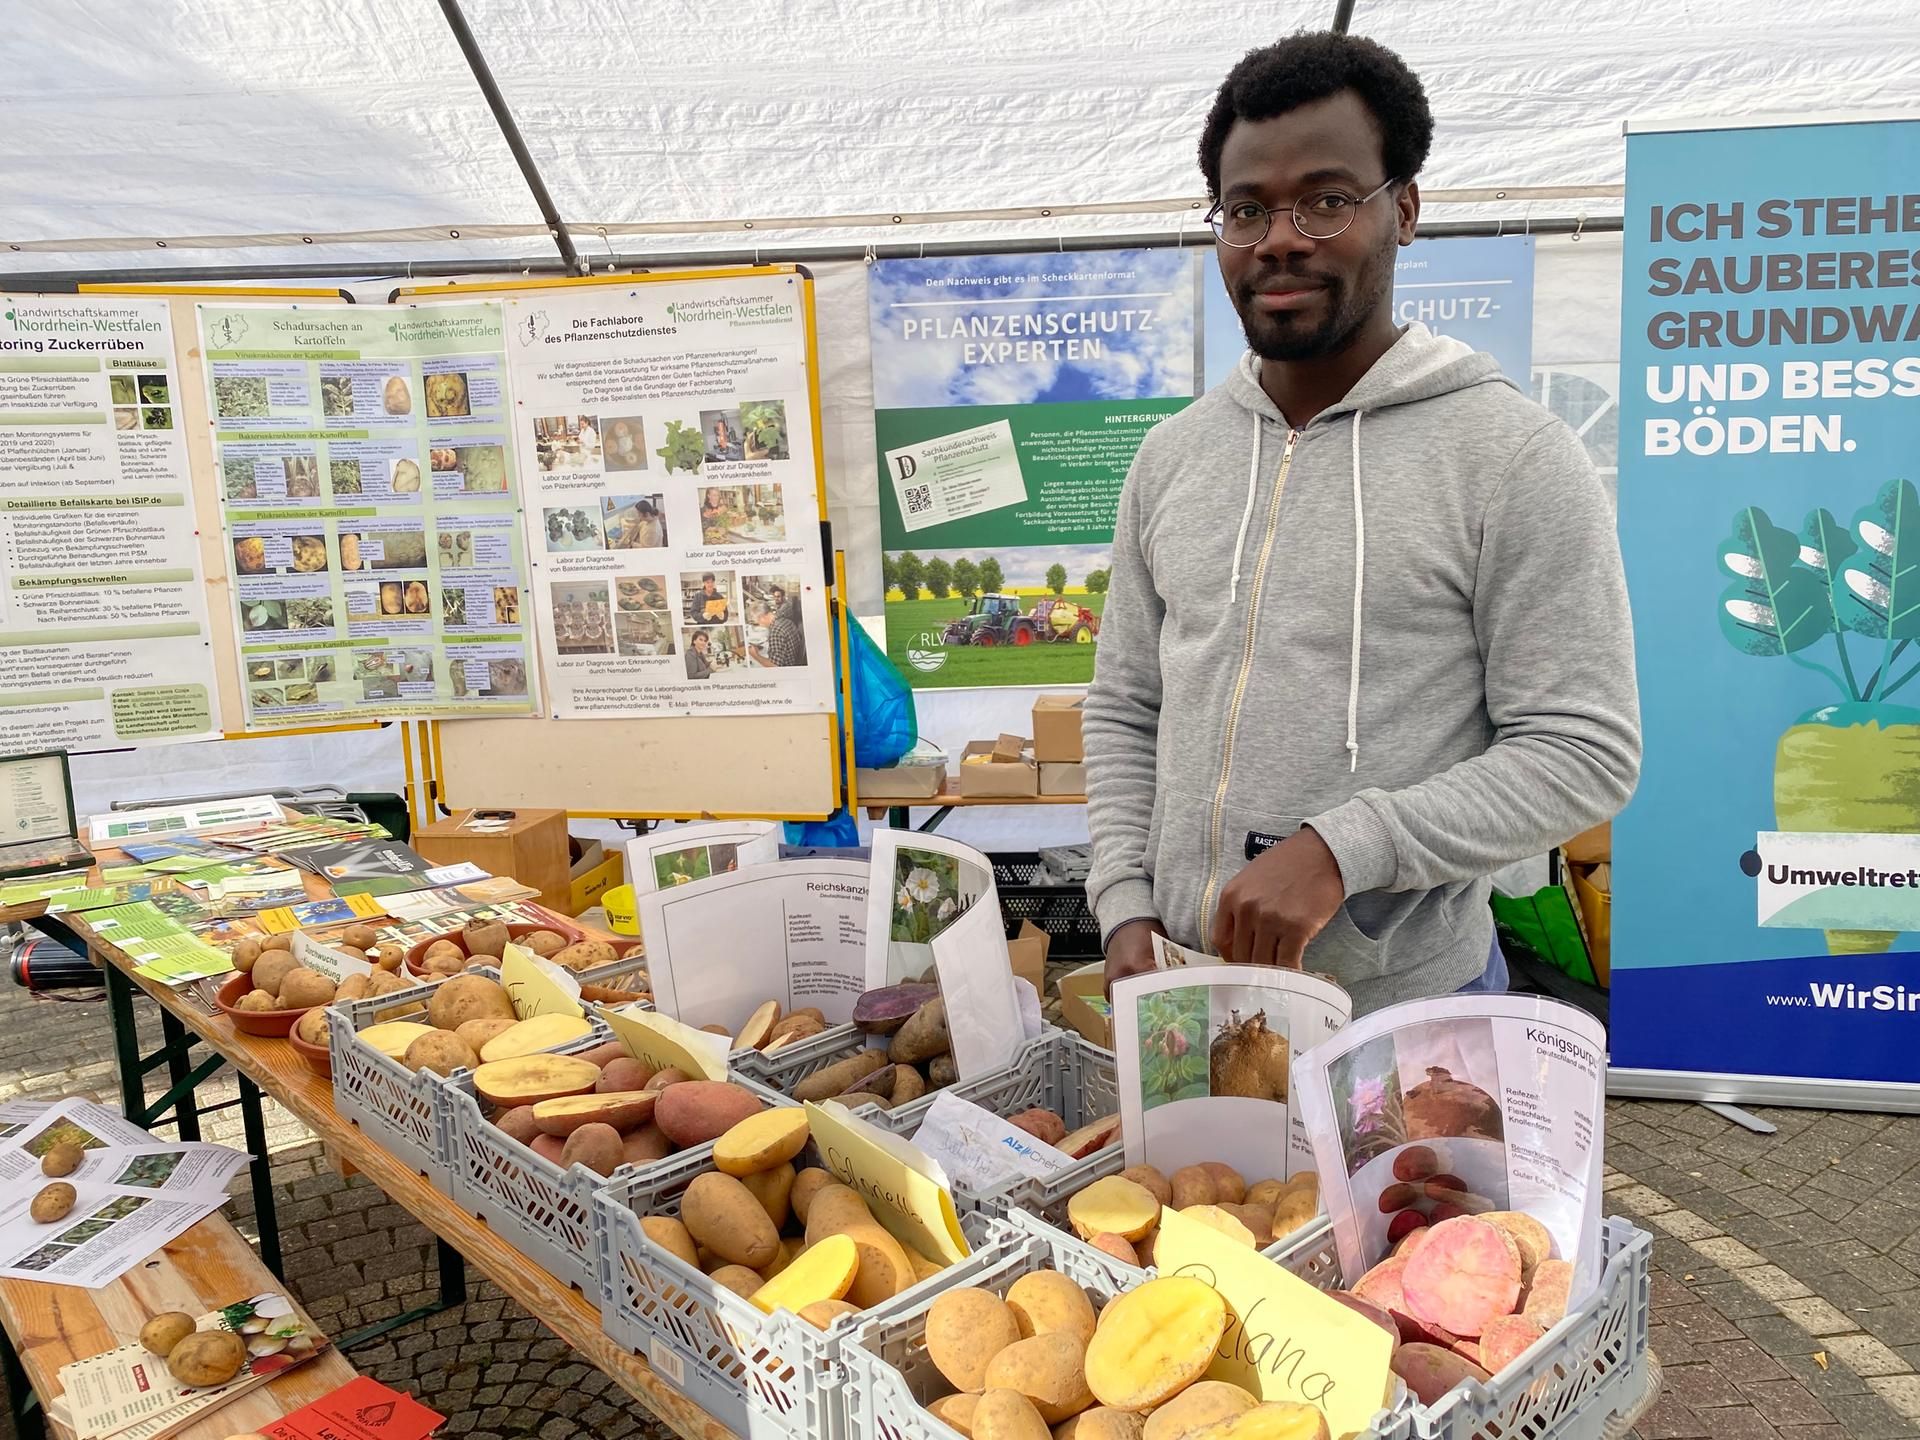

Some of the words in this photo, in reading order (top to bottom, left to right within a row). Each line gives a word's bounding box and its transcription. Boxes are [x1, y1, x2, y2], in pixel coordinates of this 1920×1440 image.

[1650, 202, 1744, 242] ICH
[1757, 194, 1920, 238] STEHE
[945, 276, 991, 286] Nachweis
[993, 275, 1012, 286] gibt
[1042, 272, 1136, 281] Scheckkartenformat
[1648, 250, 1920, 296] SAUBERE
[676, 296, 773, 312] Landwirtschaftskammer
[17, 308, 138, 319] Landwirtschaftskammer
[678, 304, 792, 324] Nordrhein-Westfalen
[19, 319, 162, 332] Nordrhein-Westfalen
[272, 321, 348, 331] Schadursachen
[399, 319, 483, 331] Landwirtschaftskammer
[572, 319, 588, 329] Die
[590, 316, 643, 327] Fachlabore
[730, 317, 792, 327] Pflanzenschutzdienst
[904, 310, 1161, 340] PFLANZENSCHUTZ-
[294, 336, 346, 345] Kartoffeln
[400, 326, 500, 341] Nordrhein-Westfalen
[544, 335, 562, 344] des
[564, 327, 677, 342] Pflanzenschutzdienstes
[48, 339, 144, 350] Zuckerrüben
[964, 339, 1101, 364] EXPERTEN
[565, 361, 611, 370] diagnostizieren
[623, 356, 671, 365] Schadursachen
[685, 349, 757, 360] Pflanzenerkrankungen!
[548, 371, 574, 379] schaffen
[603, 367, 649, 375] Voraussetzung
[690, 357, 778, 368] Pflanzenschutzmaßnahmen
[566, 378, 607, 386] entsprechend
[620, 375, 660, 383] Grundsätzen
[594, 386, 623, 394] Diagnose
[689, 379, 732, 387] Fachberatung
[1647, 364, 1769, 403] UND
[1783, 358, 1920, 399] BESS
[610, 394, 648, 402] Spezialisten
[661, 387, 736, 397] Pflanzenschutzdienstes!
[1645, 406, 1856, 456] BÖDEN.
[921, 432, 997, 458] Sachkundenachweis
[934, 442, 989, 462] Pflanzenschutz
[896, 455, 916, 480] D
[19, 576, 127, 586] Bekämpfungsschwellen
[921, 632, 947, 646] RLV
[1768, 865, 1920, 888] Umweltret
[1536, 1047, 1577, 1067] Deutschland
